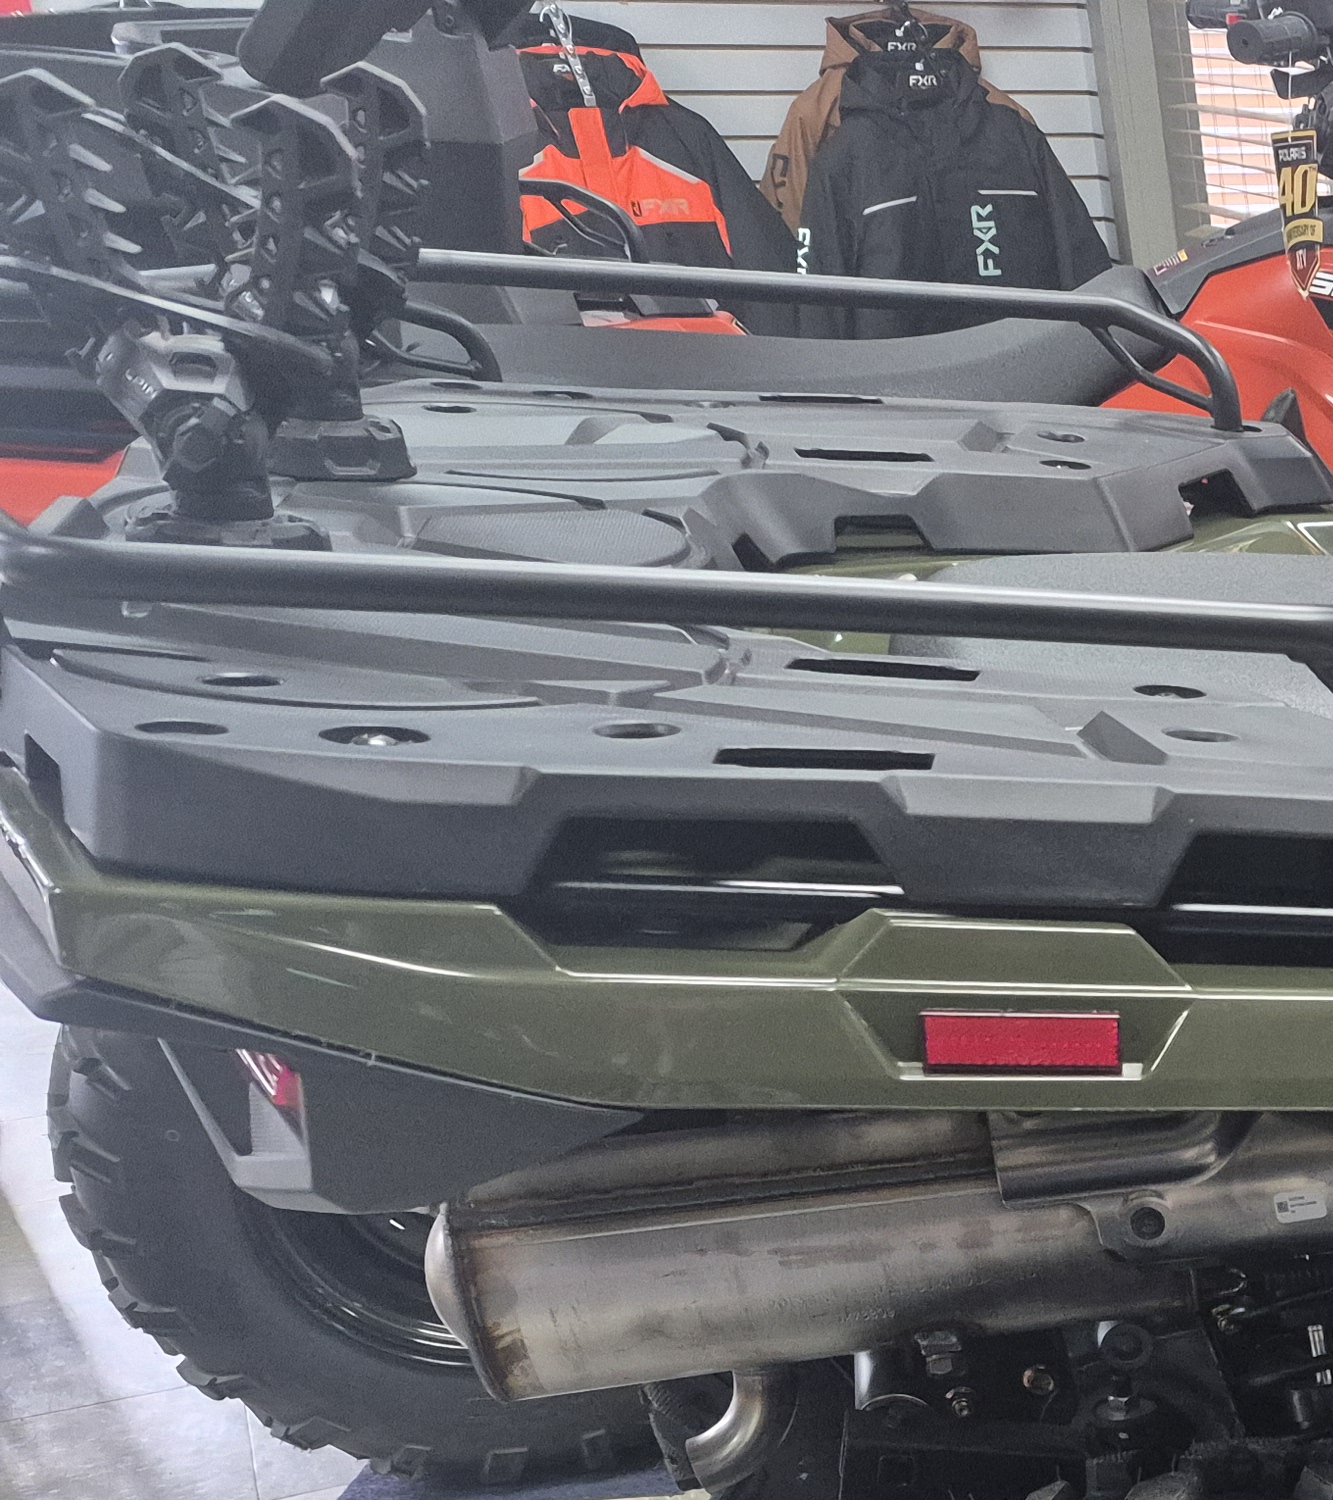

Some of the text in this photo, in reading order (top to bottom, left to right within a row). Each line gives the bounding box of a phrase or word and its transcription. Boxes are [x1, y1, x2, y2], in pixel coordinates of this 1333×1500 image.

[909, 74, 938, 88] FXR
[642, 198, 691, 216] FXR
[1279, 163, 1318, 218] 40
[970, 203, 1003, 277] FXR
